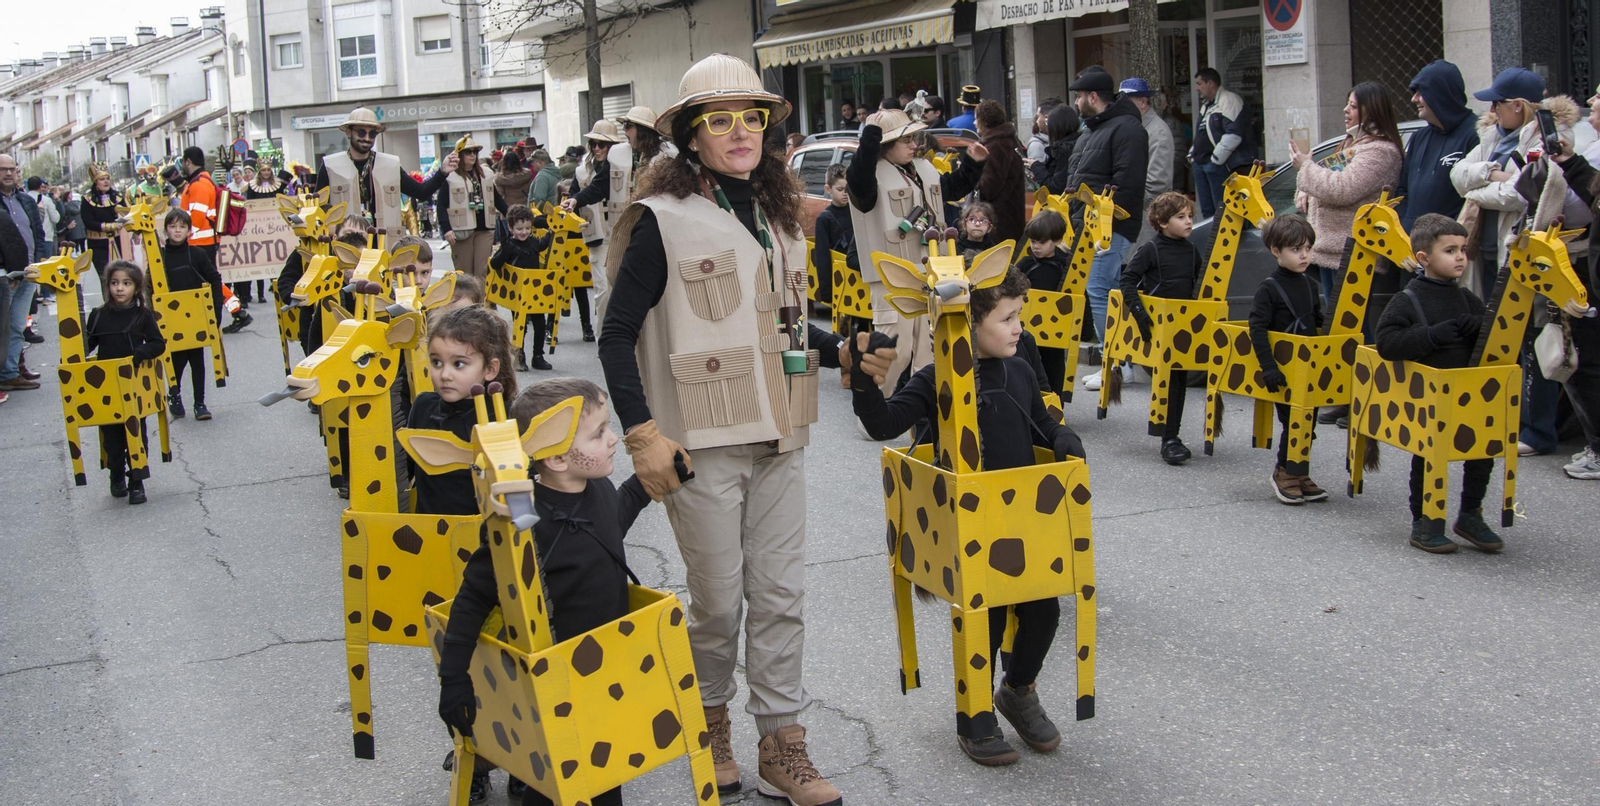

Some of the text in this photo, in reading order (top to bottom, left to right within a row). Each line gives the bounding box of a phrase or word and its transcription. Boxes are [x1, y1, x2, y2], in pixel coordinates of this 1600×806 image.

[1001, 4, 1038, 20] DESPACHO
[1043, 0, 1054, 14] DE
[1059, 0, 1075, 11] PAN
[785, 25, 913, 58] PRENSA LAMBISCADAS ACEITUNAS
[388, 103, 464, 118] ortopedia
[251, 224, 265, 235] da
[266, 222, 290, 235] Barr
[218, 238, 288, 267] EXIPTO
